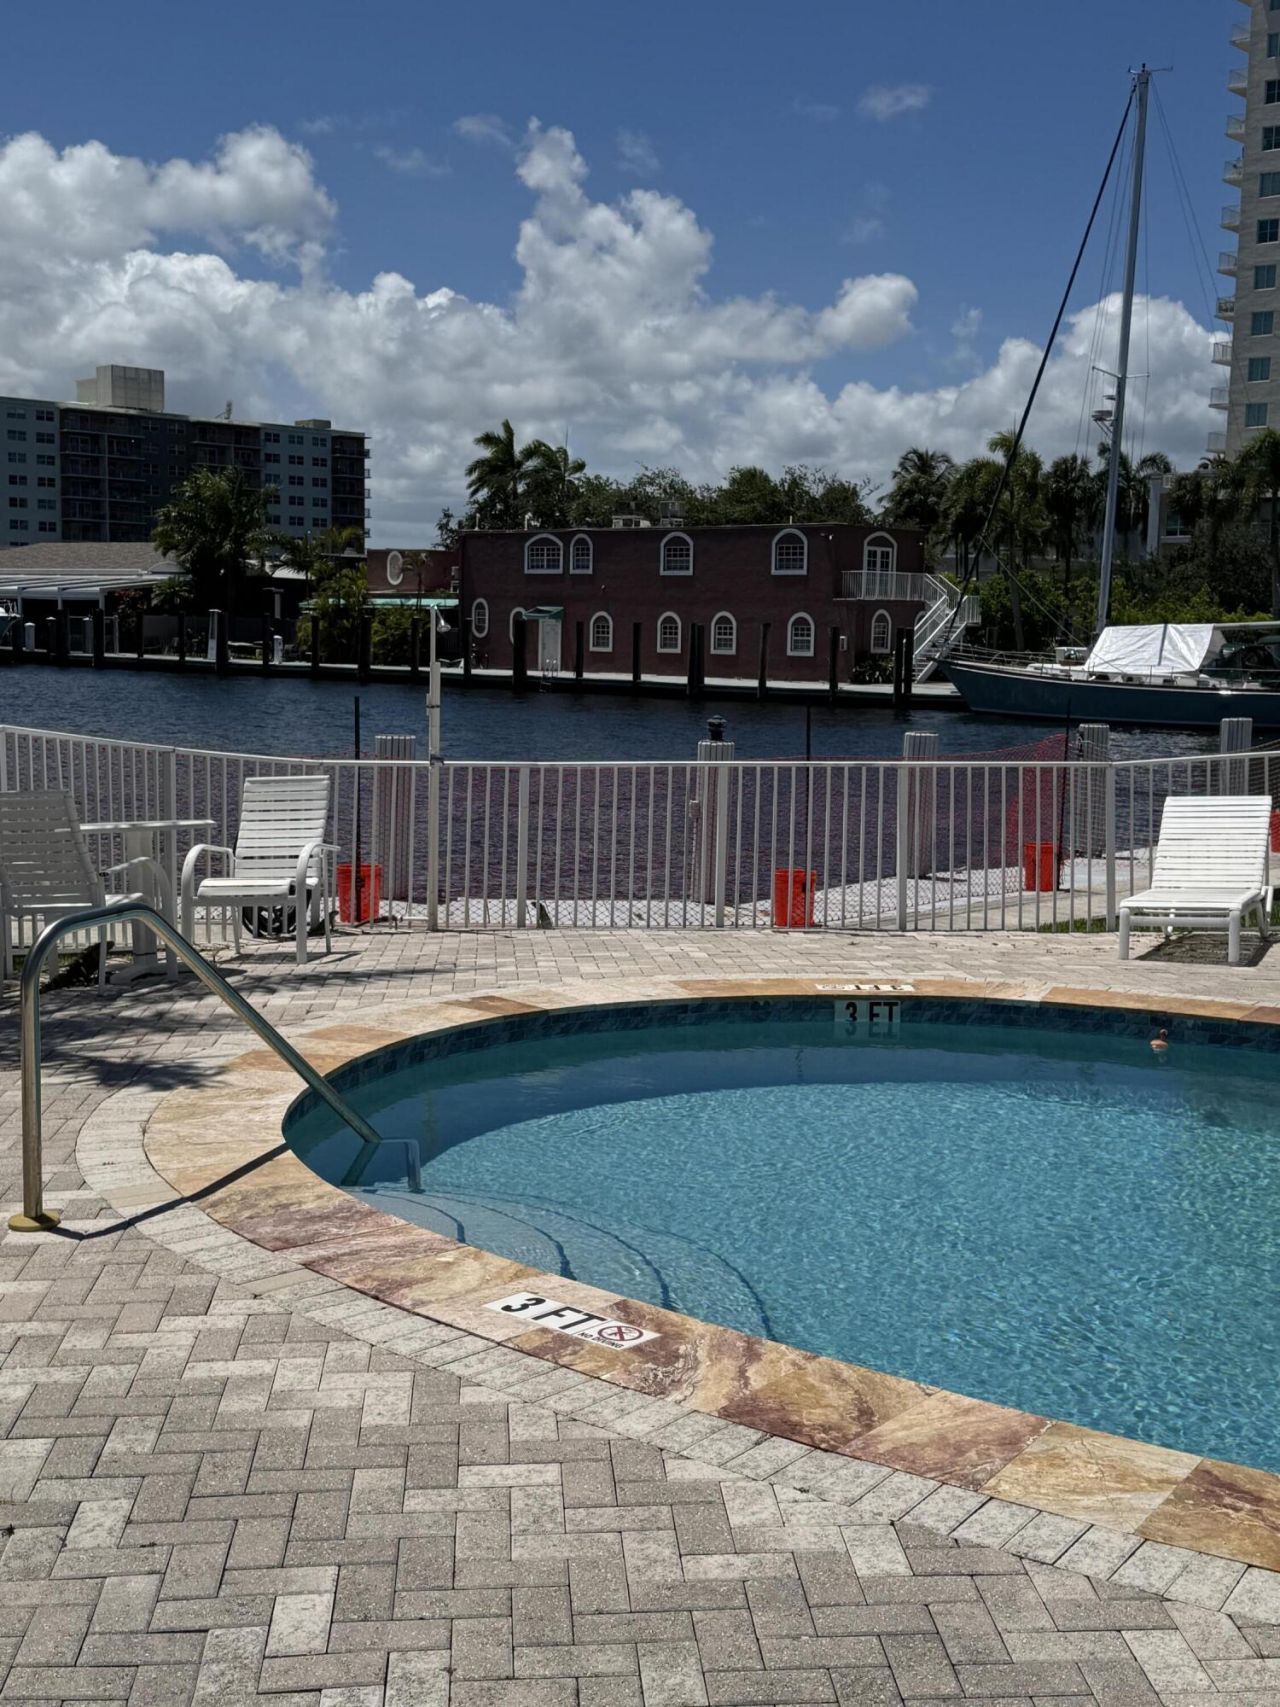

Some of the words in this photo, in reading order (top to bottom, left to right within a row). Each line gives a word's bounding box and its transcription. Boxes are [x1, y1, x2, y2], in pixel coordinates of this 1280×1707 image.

[845, 1002, 858, 1021] 3
[869, 1002, 899, 1022] FT
[501, 1297, 546, 1313] 3
[531, 1306, 607, 1330] FT
[578, 1331, 593, 1339] NO
[591, 1336, 625, 1349] DIVING
